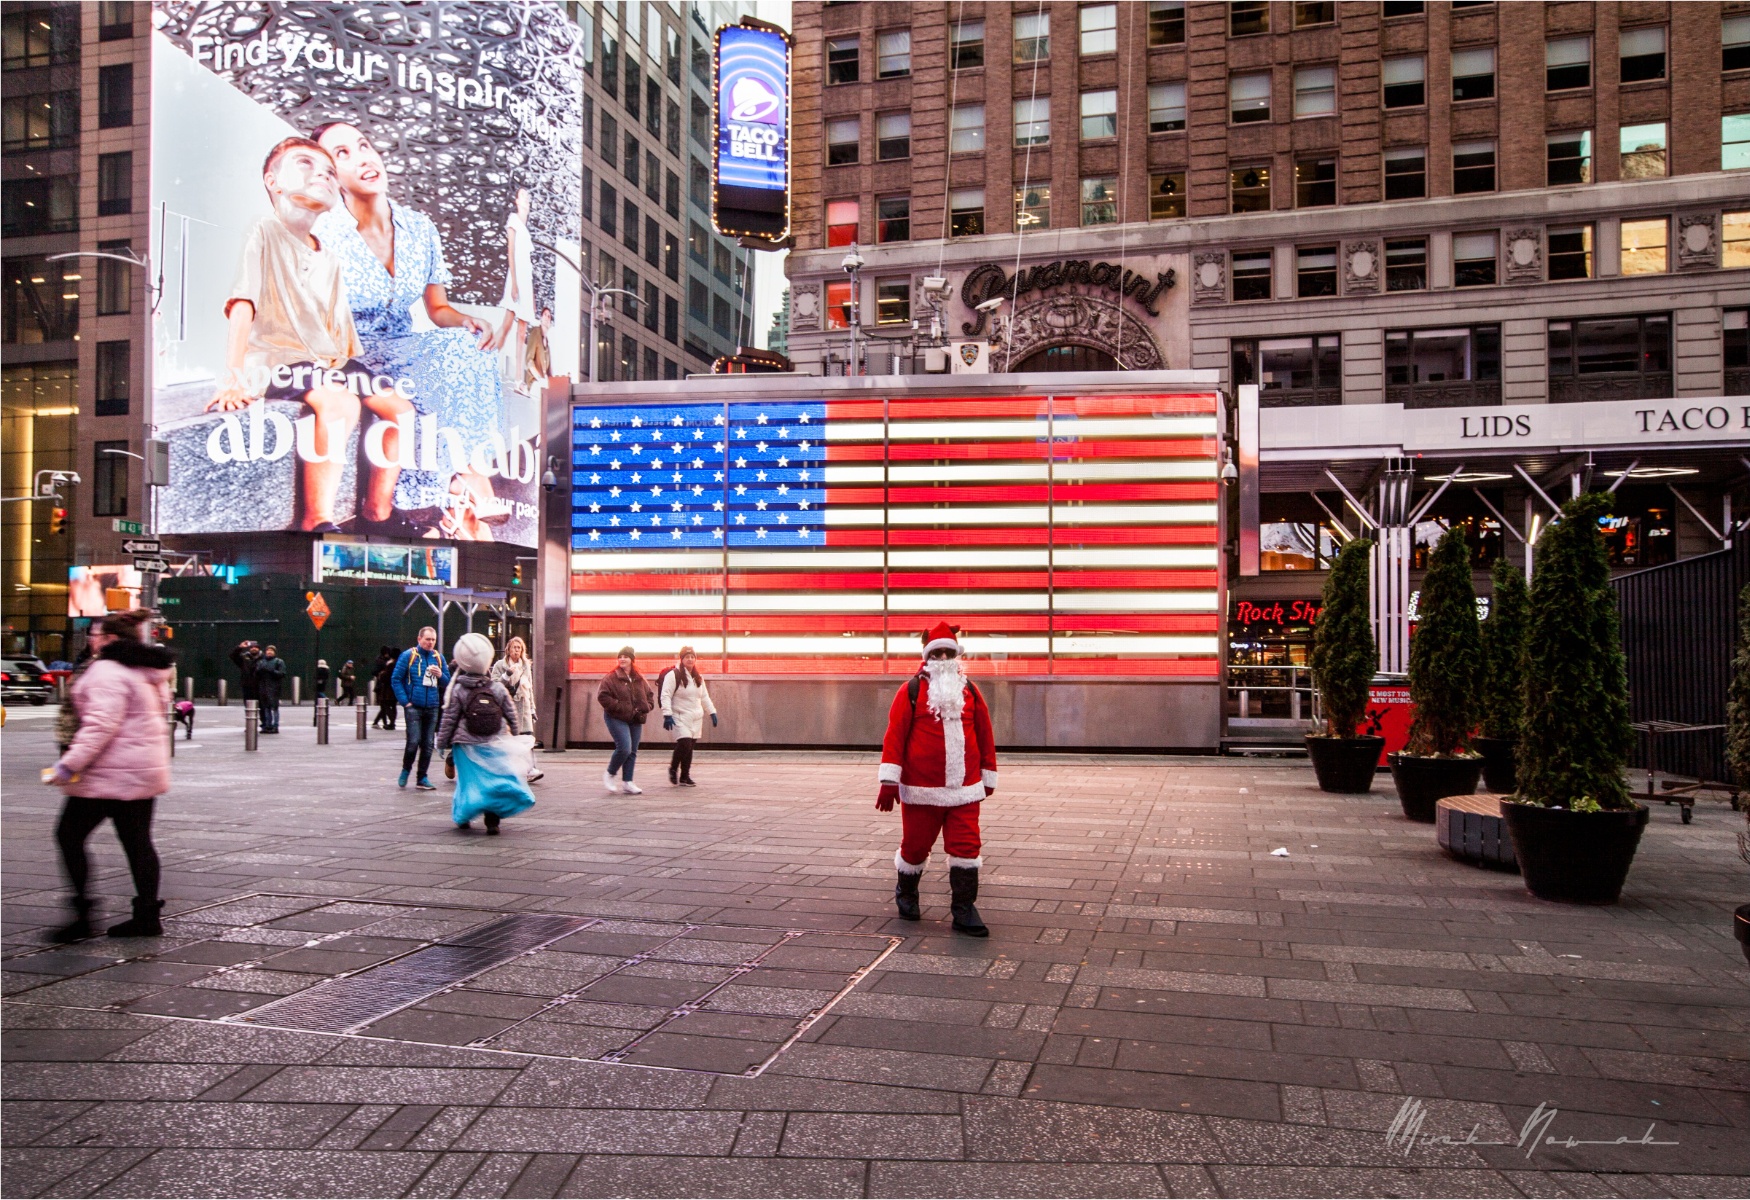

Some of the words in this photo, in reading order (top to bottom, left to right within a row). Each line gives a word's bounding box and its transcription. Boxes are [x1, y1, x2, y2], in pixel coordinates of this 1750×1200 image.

[192, 29, 268, 72] Find
[277, 32, 389, 82] your
[397, 53, 561, 151] inspiration
[727, 124, 779, 146] TACO
[731, 141, 780, 162] BELL
[961, 260, 1176, 336] Paramount
[215, 361, 418, 399] experience
[1460, 414, 1532, 438] LIDS
[1635, 406, 1730, 432] TACO
[206, 398, 349, 463] abu
[364, 408, 540, 487] dhabi
[1237, 601, 1284, 625] Rock
